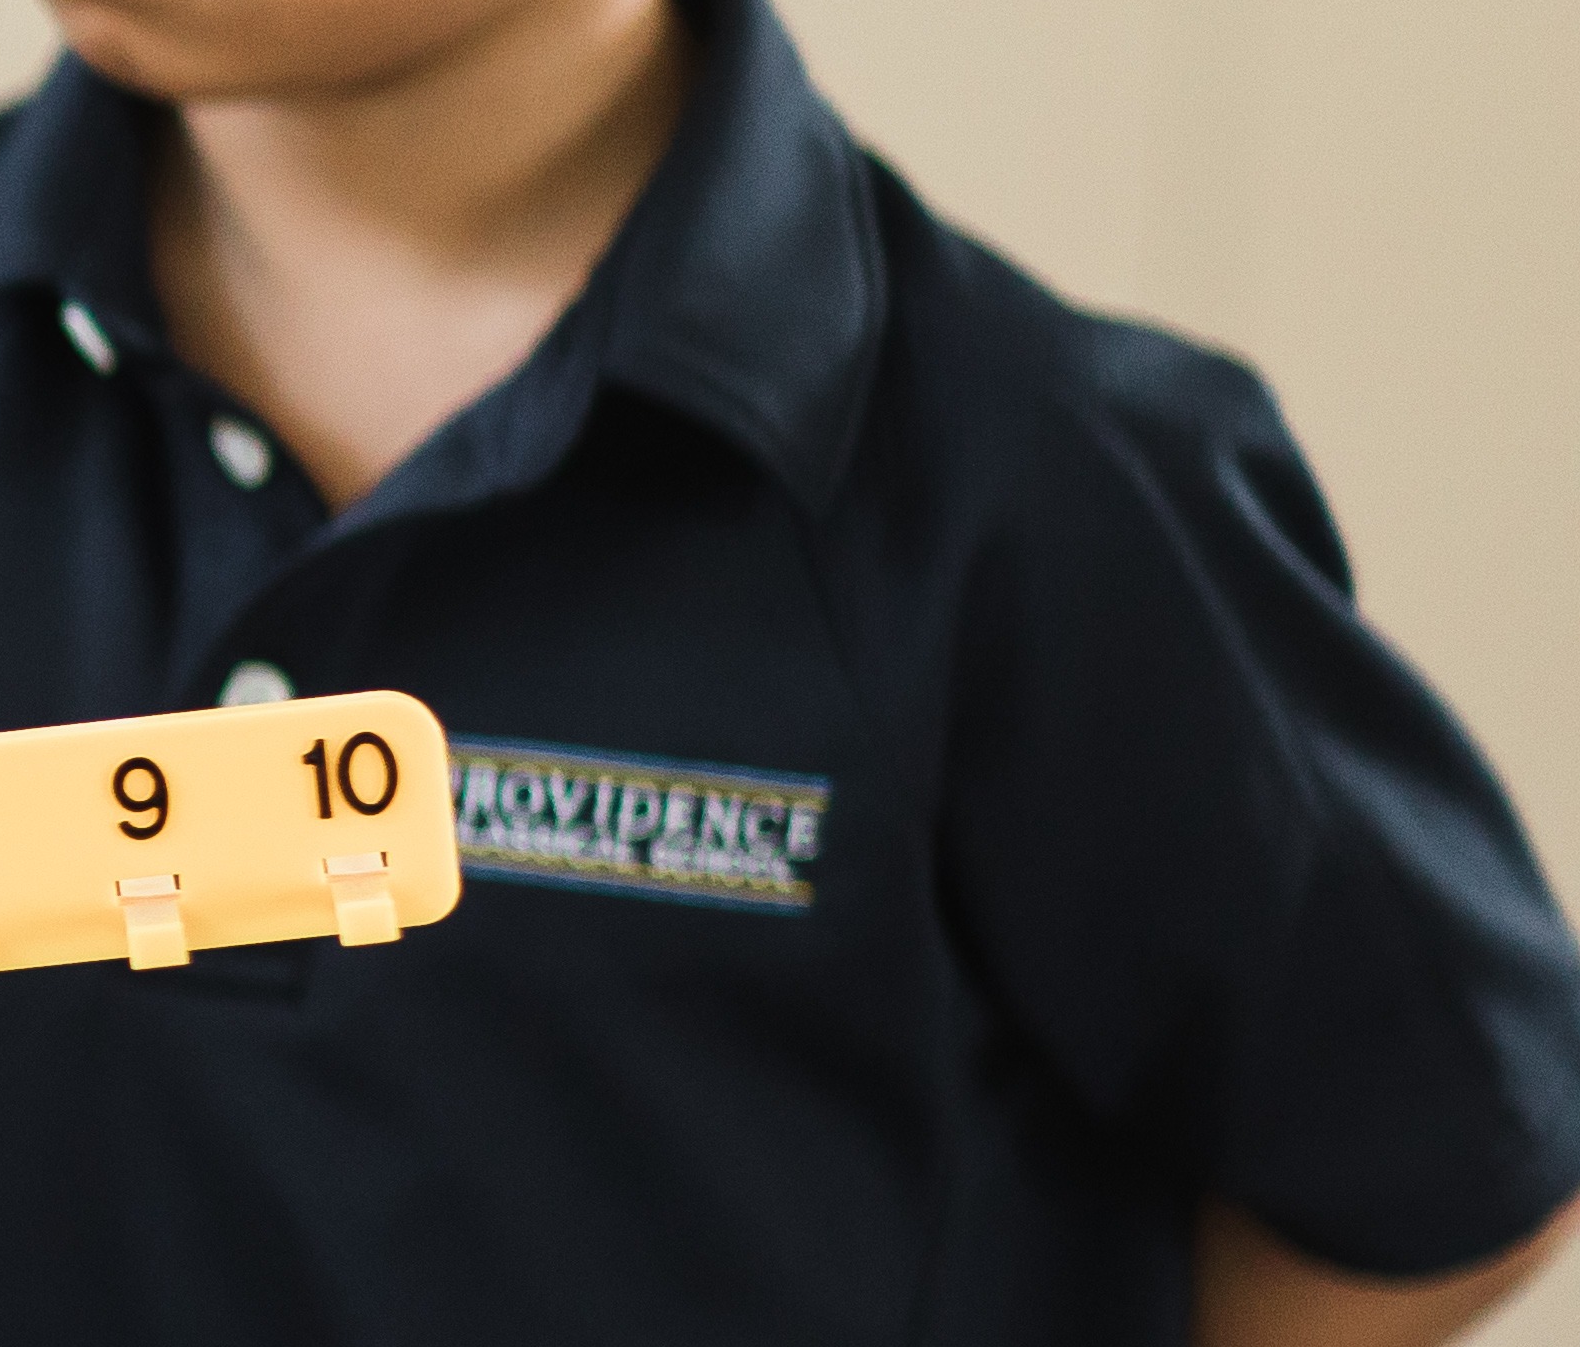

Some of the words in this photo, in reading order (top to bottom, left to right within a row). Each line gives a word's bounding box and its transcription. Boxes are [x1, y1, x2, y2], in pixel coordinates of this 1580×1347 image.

[111, 755, 170, 842] 9
[301, 730, 400, 821] 10
[451, 758, 821, 861] ROVIDENCE
